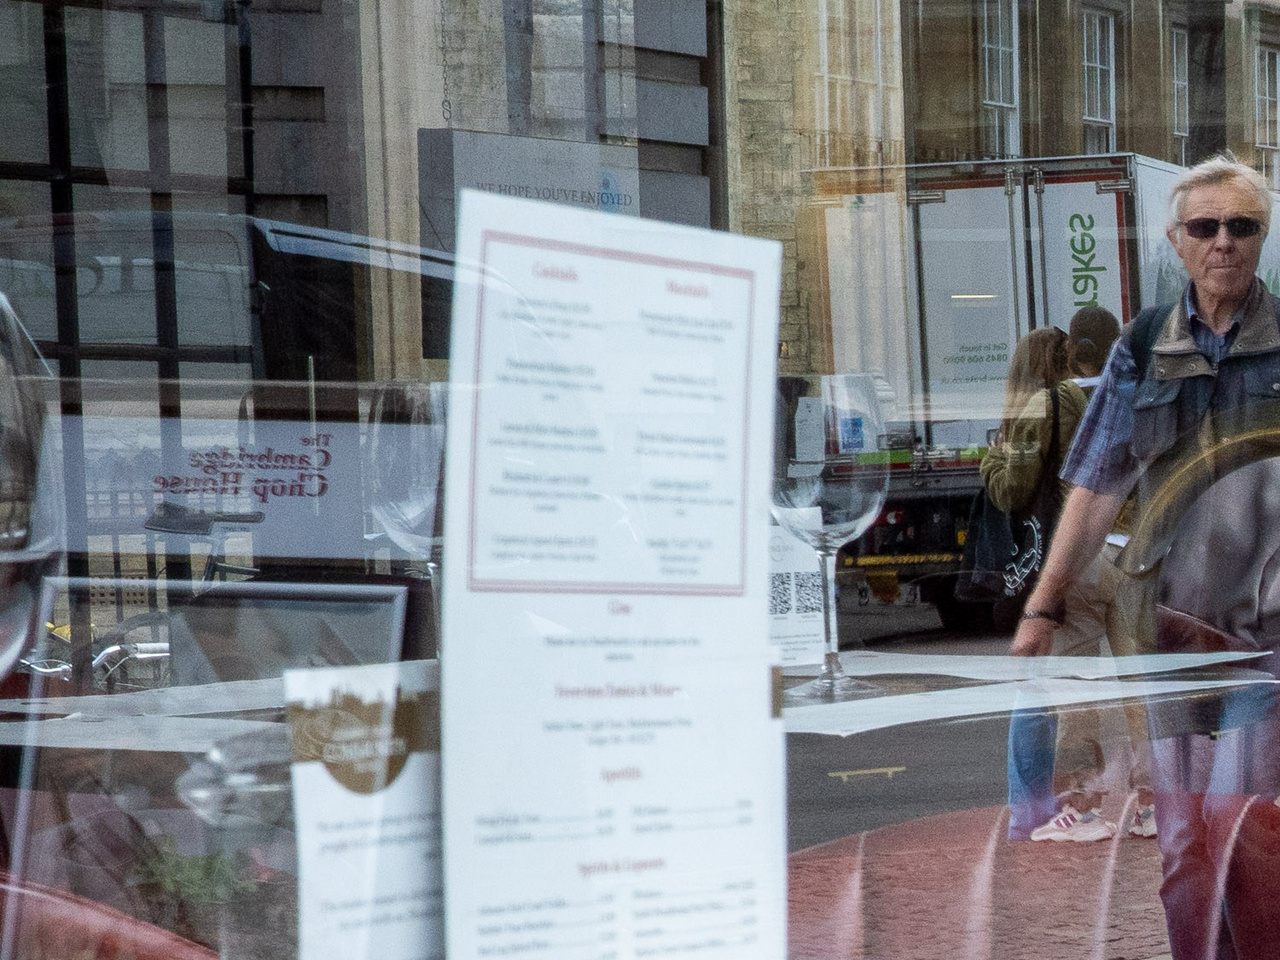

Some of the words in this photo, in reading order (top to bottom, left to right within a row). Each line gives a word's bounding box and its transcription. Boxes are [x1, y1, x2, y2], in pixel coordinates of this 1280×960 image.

[499, 184, 529, 199] HOPE
[534, 187, 578, 202] YOU'VE
[580, 190, 632, 207] ENJOYED
